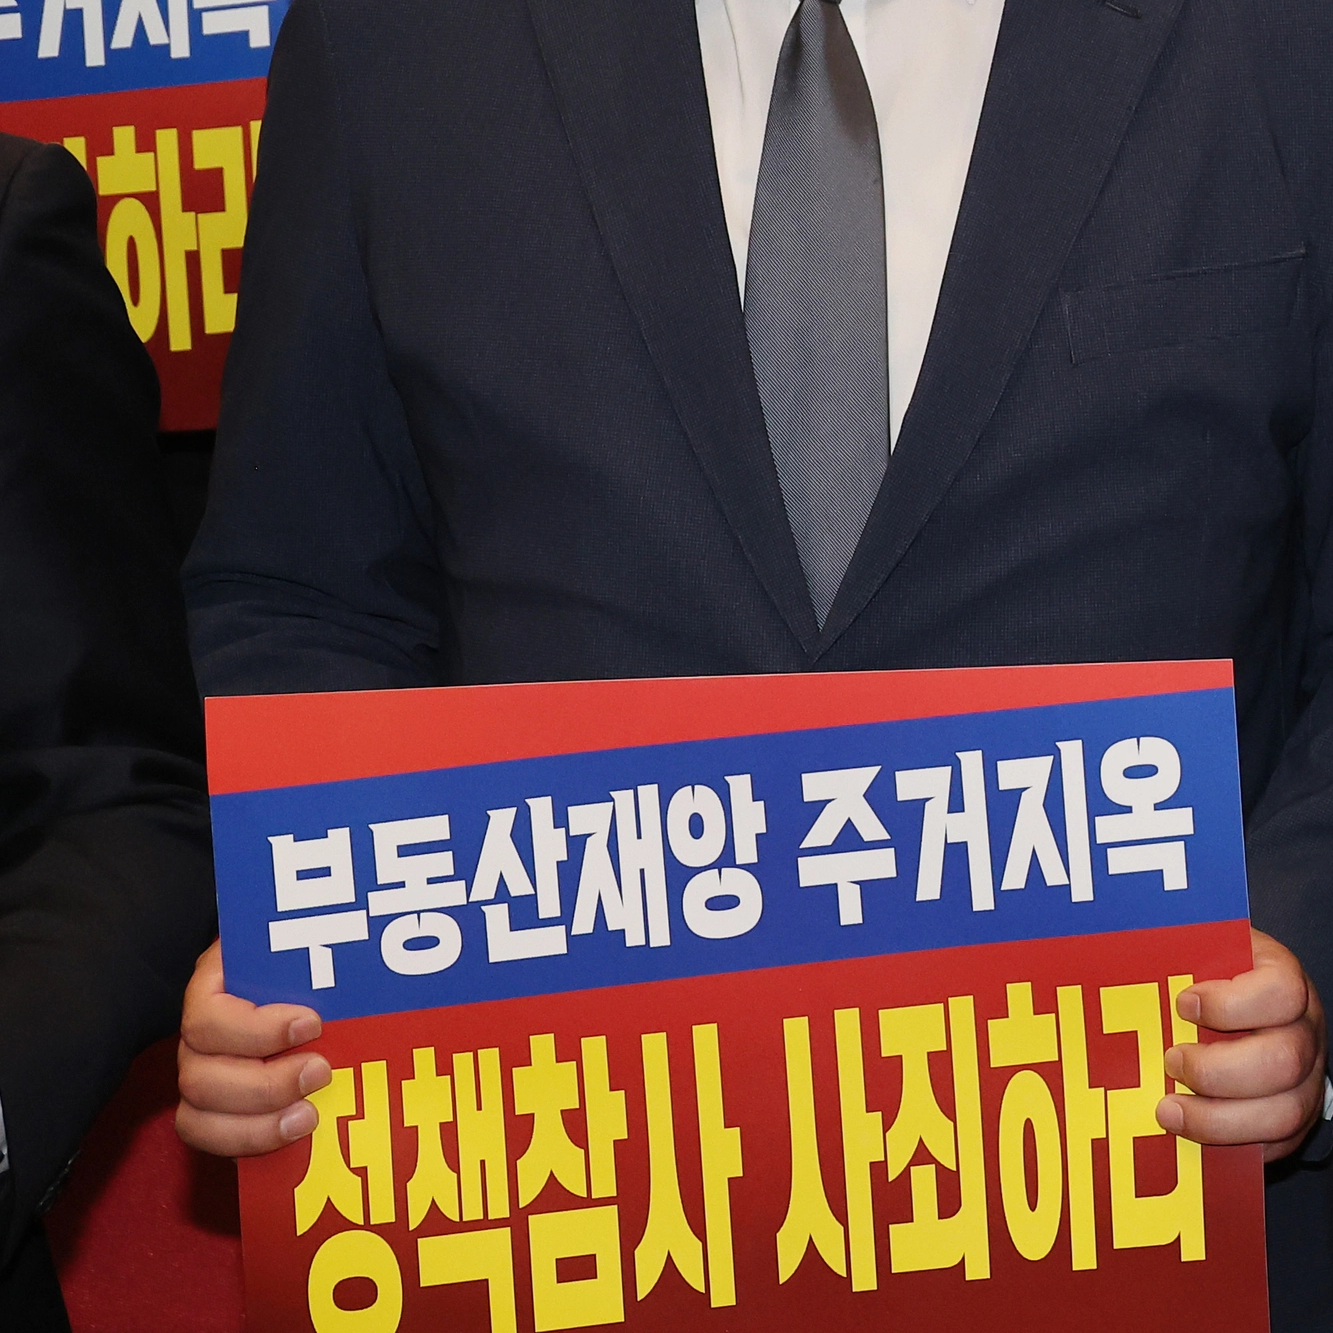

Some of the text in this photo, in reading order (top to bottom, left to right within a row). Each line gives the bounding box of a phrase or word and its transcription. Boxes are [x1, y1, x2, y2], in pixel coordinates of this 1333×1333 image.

[267, 736, 1194, 990] 부동산재앙 주거지옥
[293, 1022, 744, 1333] 정책참사
